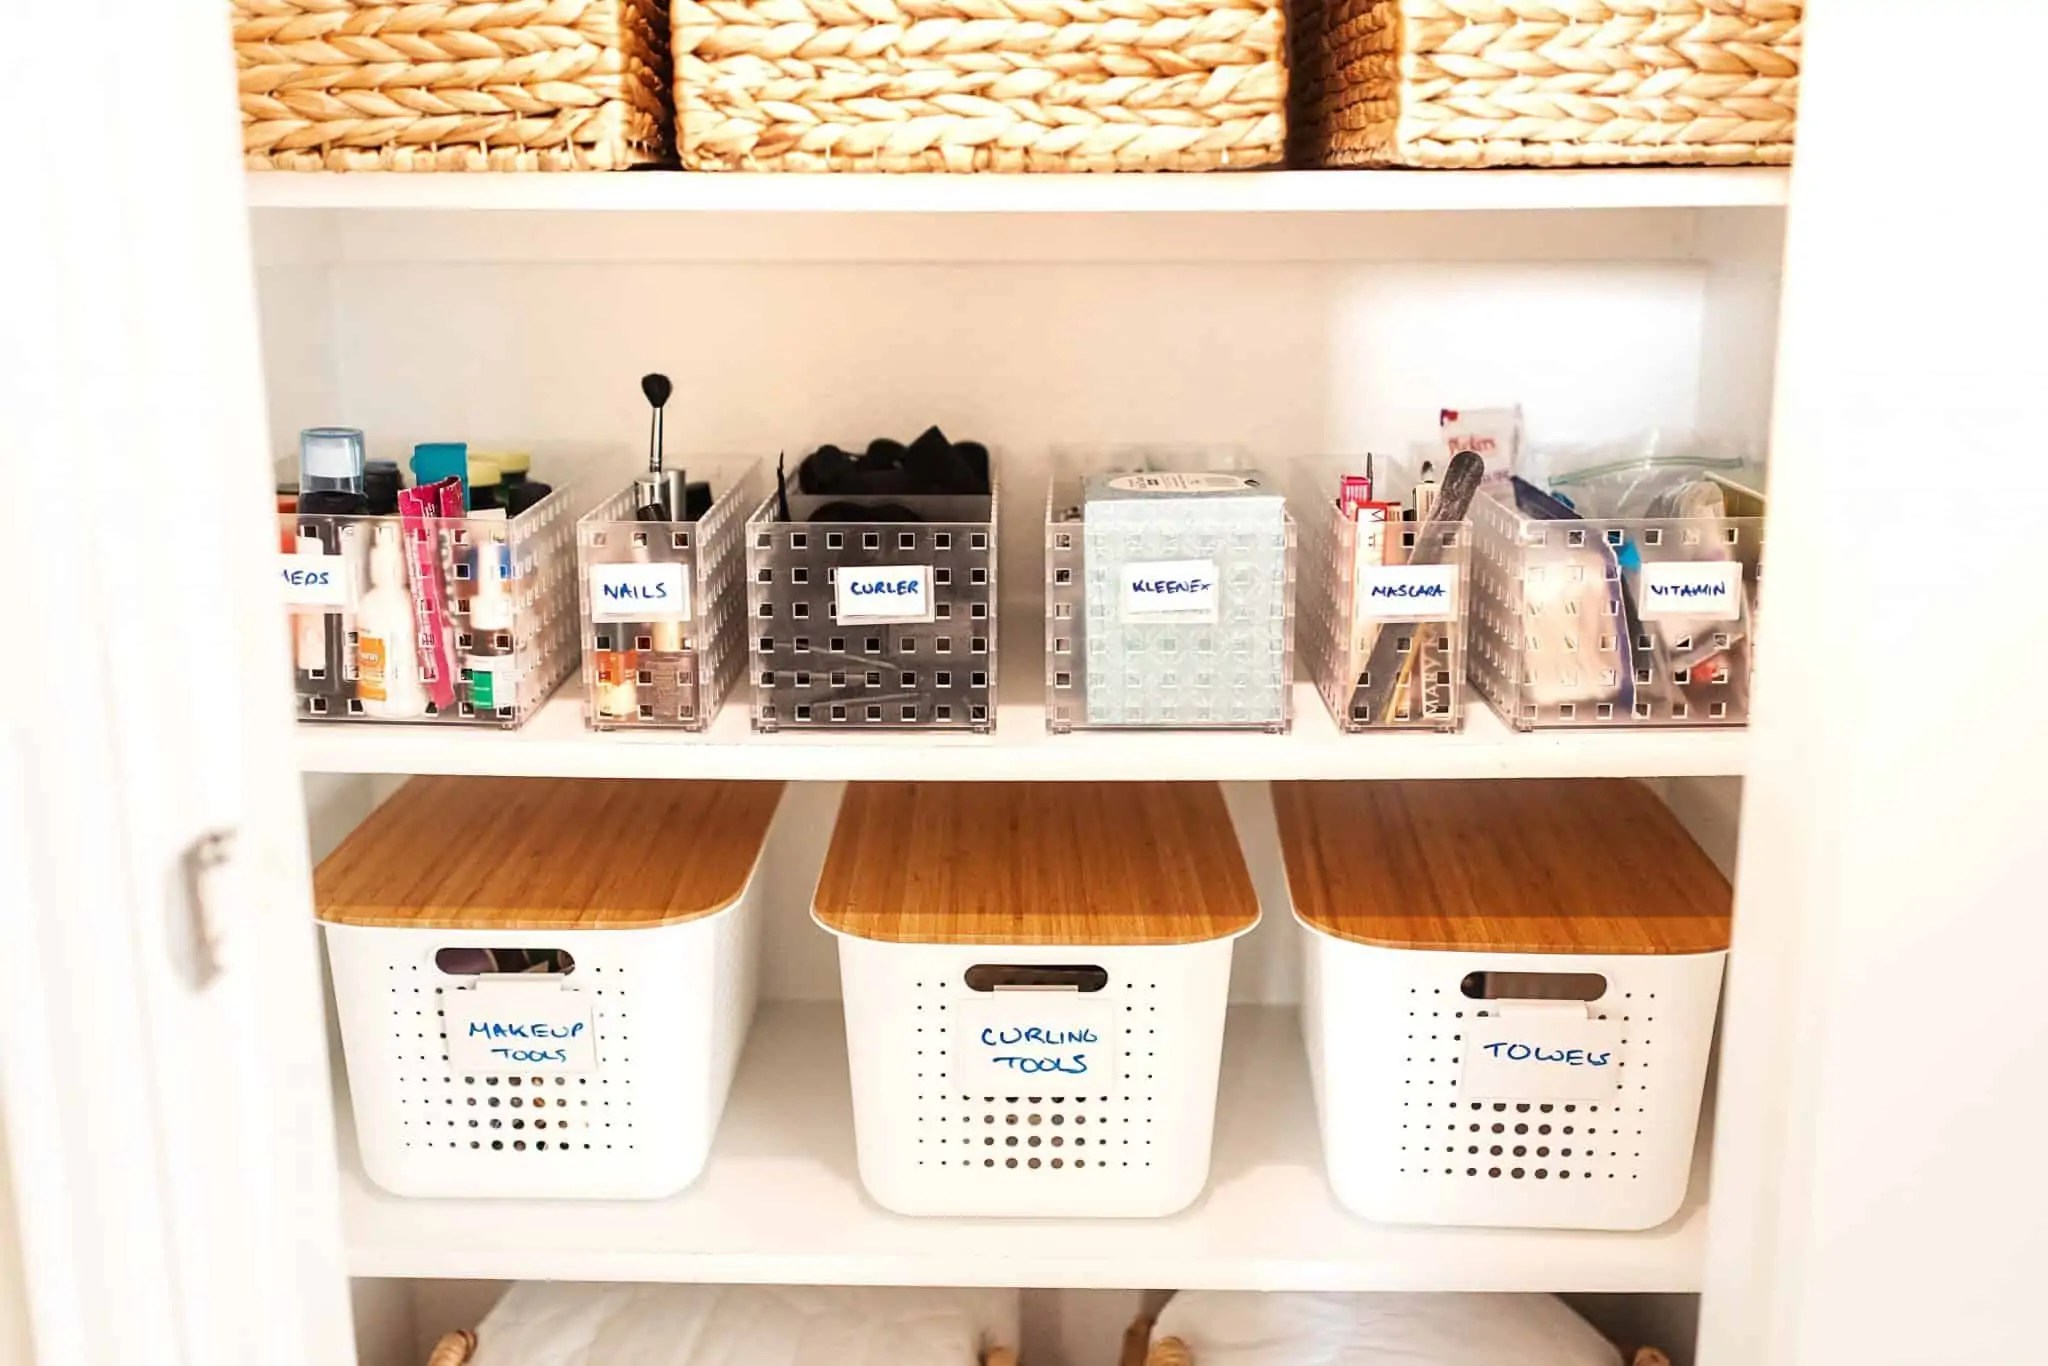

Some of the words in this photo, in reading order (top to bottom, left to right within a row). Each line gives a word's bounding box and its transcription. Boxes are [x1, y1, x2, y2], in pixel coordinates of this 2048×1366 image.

[603, 582, 667, 600] NAILS
[849, 579, 920, 596] CURLER
[1132, 578, 1212, 595] KLEENEX
[1371, 583, 1447, 600] MASCARA
[1650, 581, 1726, 598] VITAMIN
[468, 1021, 585, 1040] MAKEUP
[980, 1026, 1098, 1047] CURLING
[490, 1048, 567, 1063] TOOLS
[1484, 1042, 1610, 1067] TOWELS
[990, 1053, 1088, 1075] TOOLS
